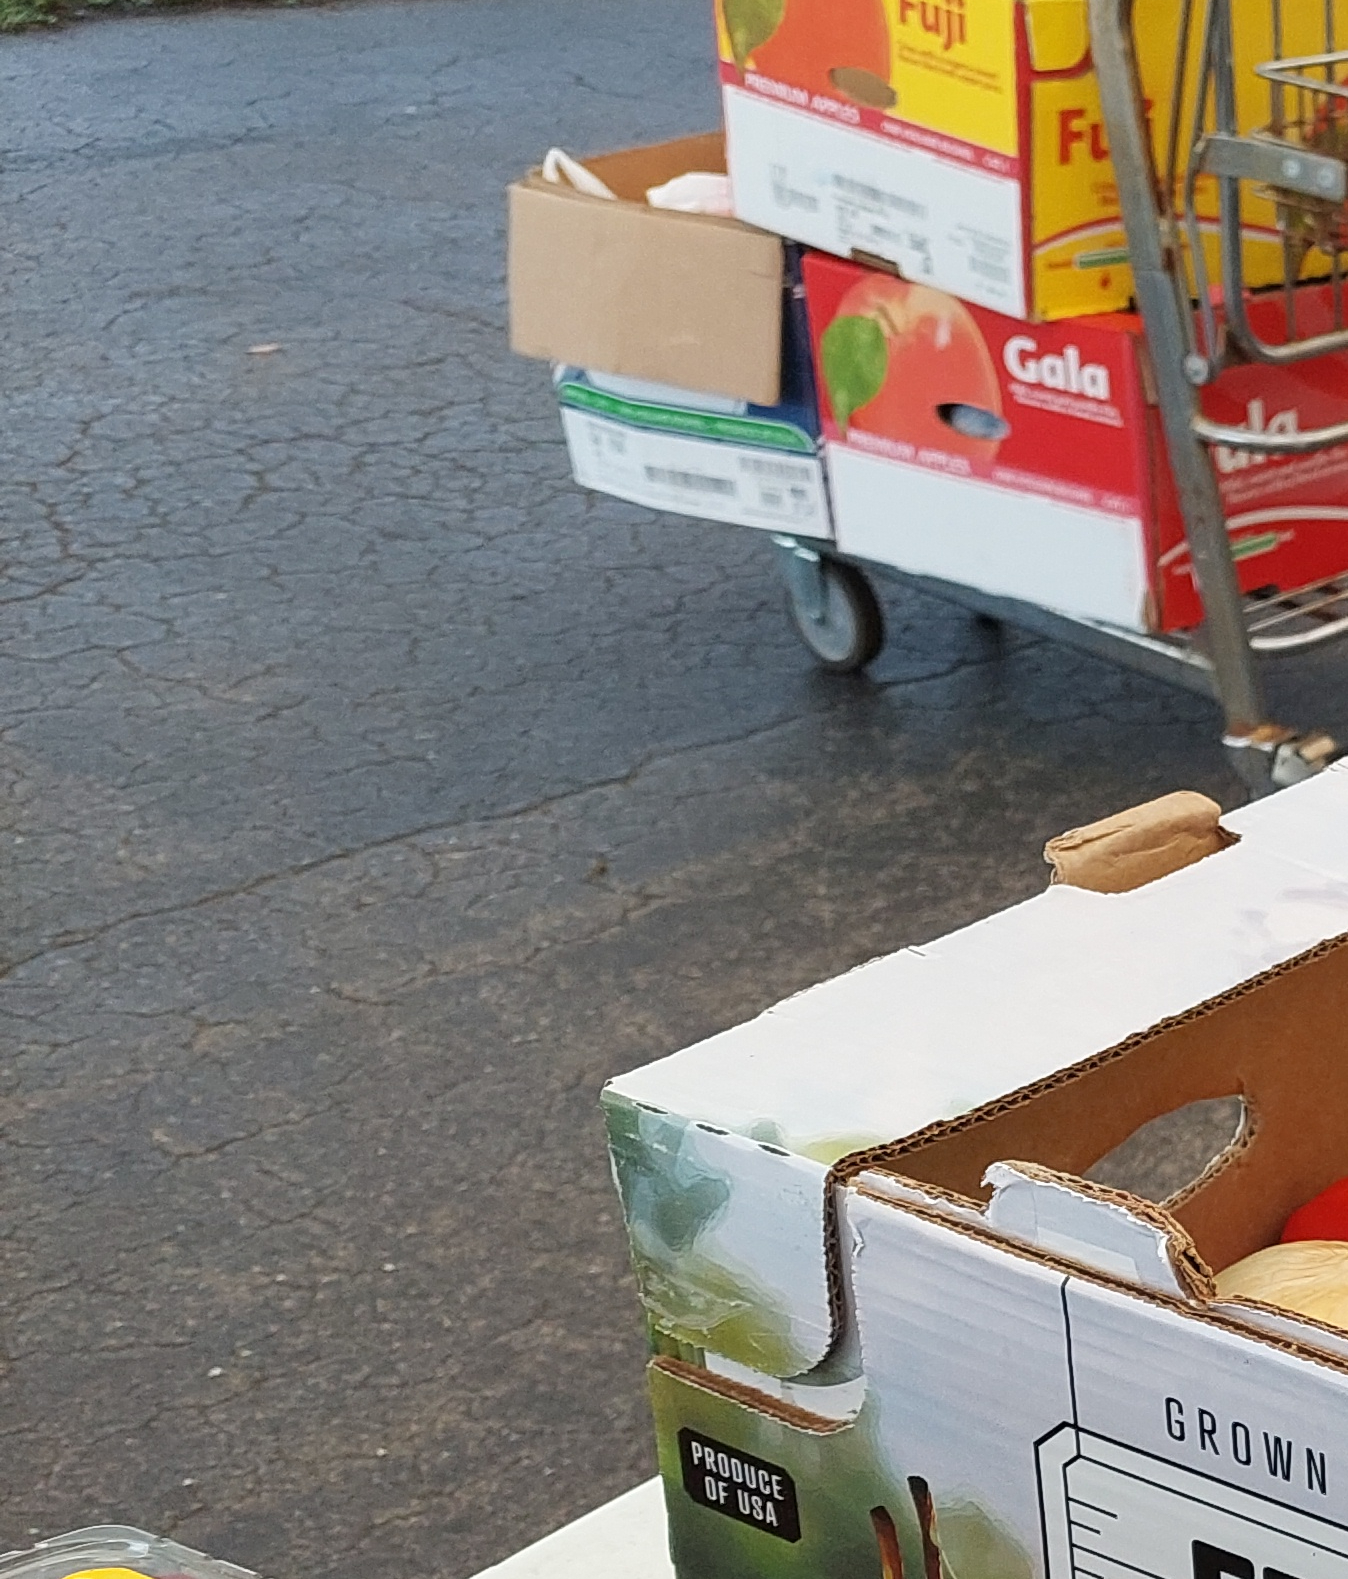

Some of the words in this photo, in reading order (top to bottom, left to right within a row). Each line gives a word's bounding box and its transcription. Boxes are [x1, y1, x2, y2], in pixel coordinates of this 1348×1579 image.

[898, 0, 967, 51] Fuji
[1002, 333, 1111, 401] Gala
[690, 1441, 785, 1501] PRODUCE
[1164, 1396, 1331, 1498] GROWN
[704, 1476, 730, 1505] OF
[736, 1489, 779, 1528] USA
